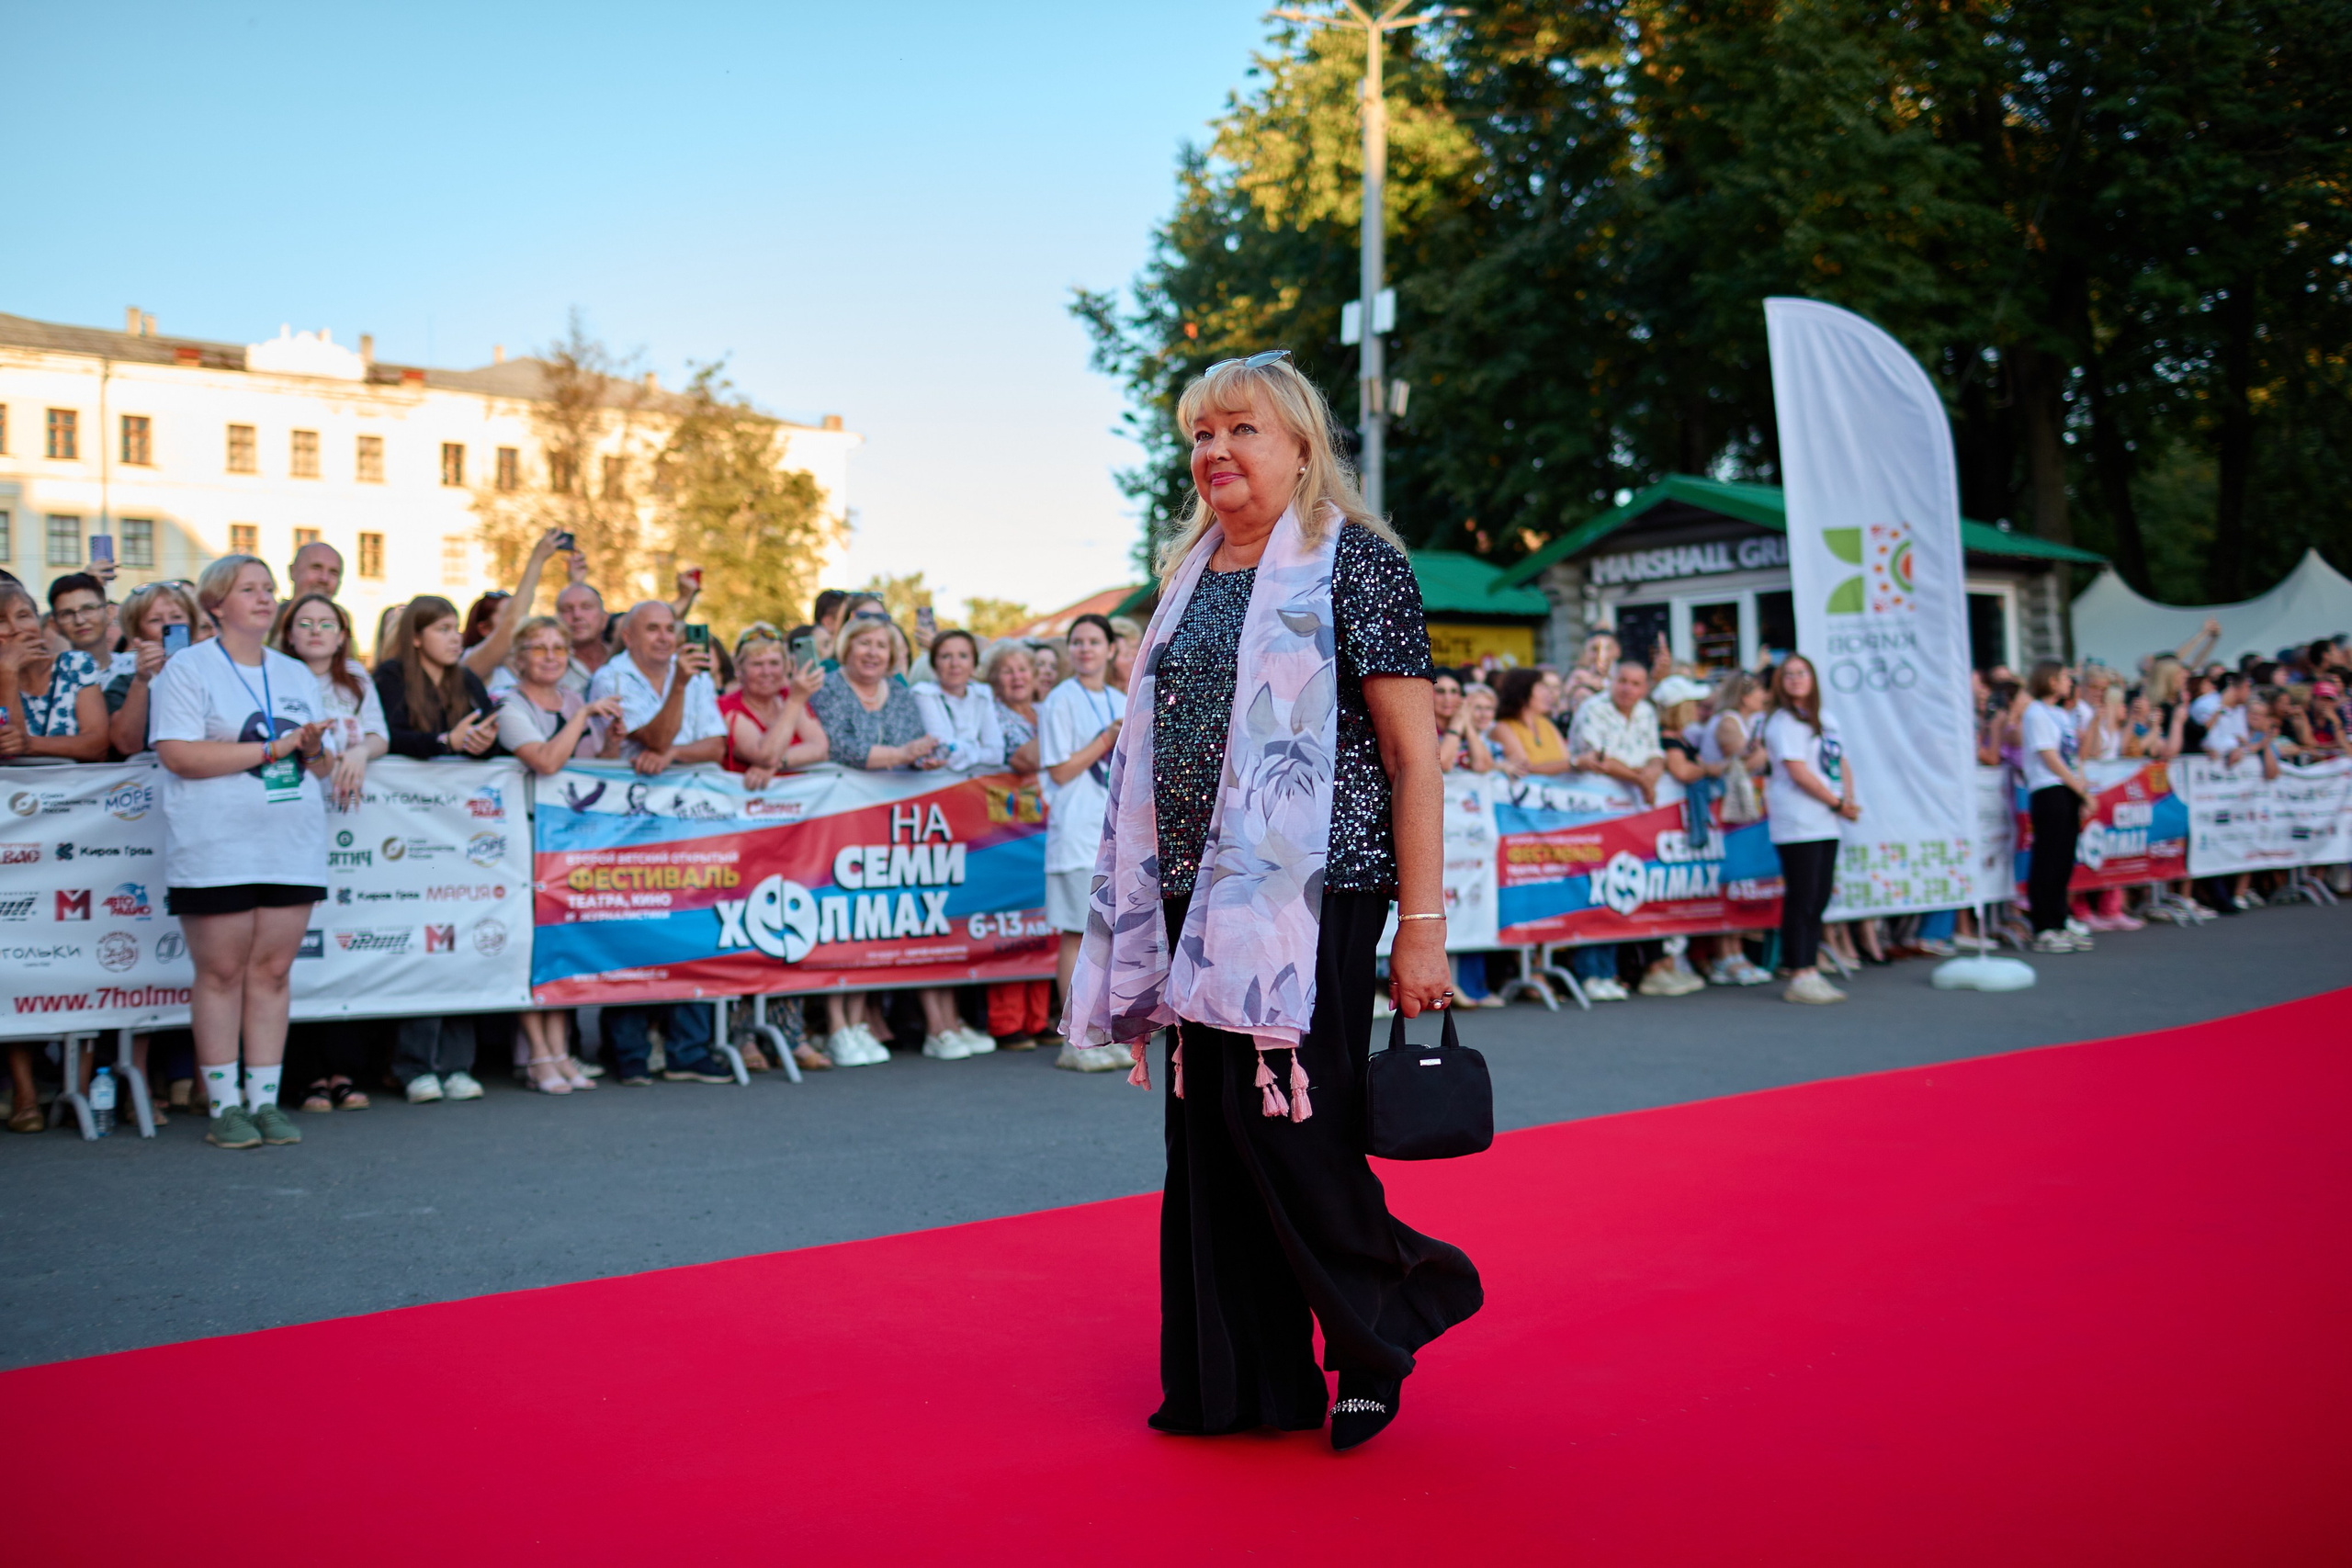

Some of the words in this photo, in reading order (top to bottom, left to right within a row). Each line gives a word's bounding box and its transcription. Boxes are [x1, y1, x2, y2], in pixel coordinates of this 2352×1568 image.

[1590, 541, 1735, 585] MARSHALL
[104, 785, 153, 812] МОРЕ
[891, 803, 953, 843] НА
[80, 847, 120, 860] Киров
[833, 844, 967, 890] СЕМИ
[568, 865, 741, 892] ФЕСТИВАЛЬ
[631, 893, 673, 908] КИНО
[968, 911, 1023, 940] 6-13
[0, 943, 82, 960] ГОЛЬКИ
